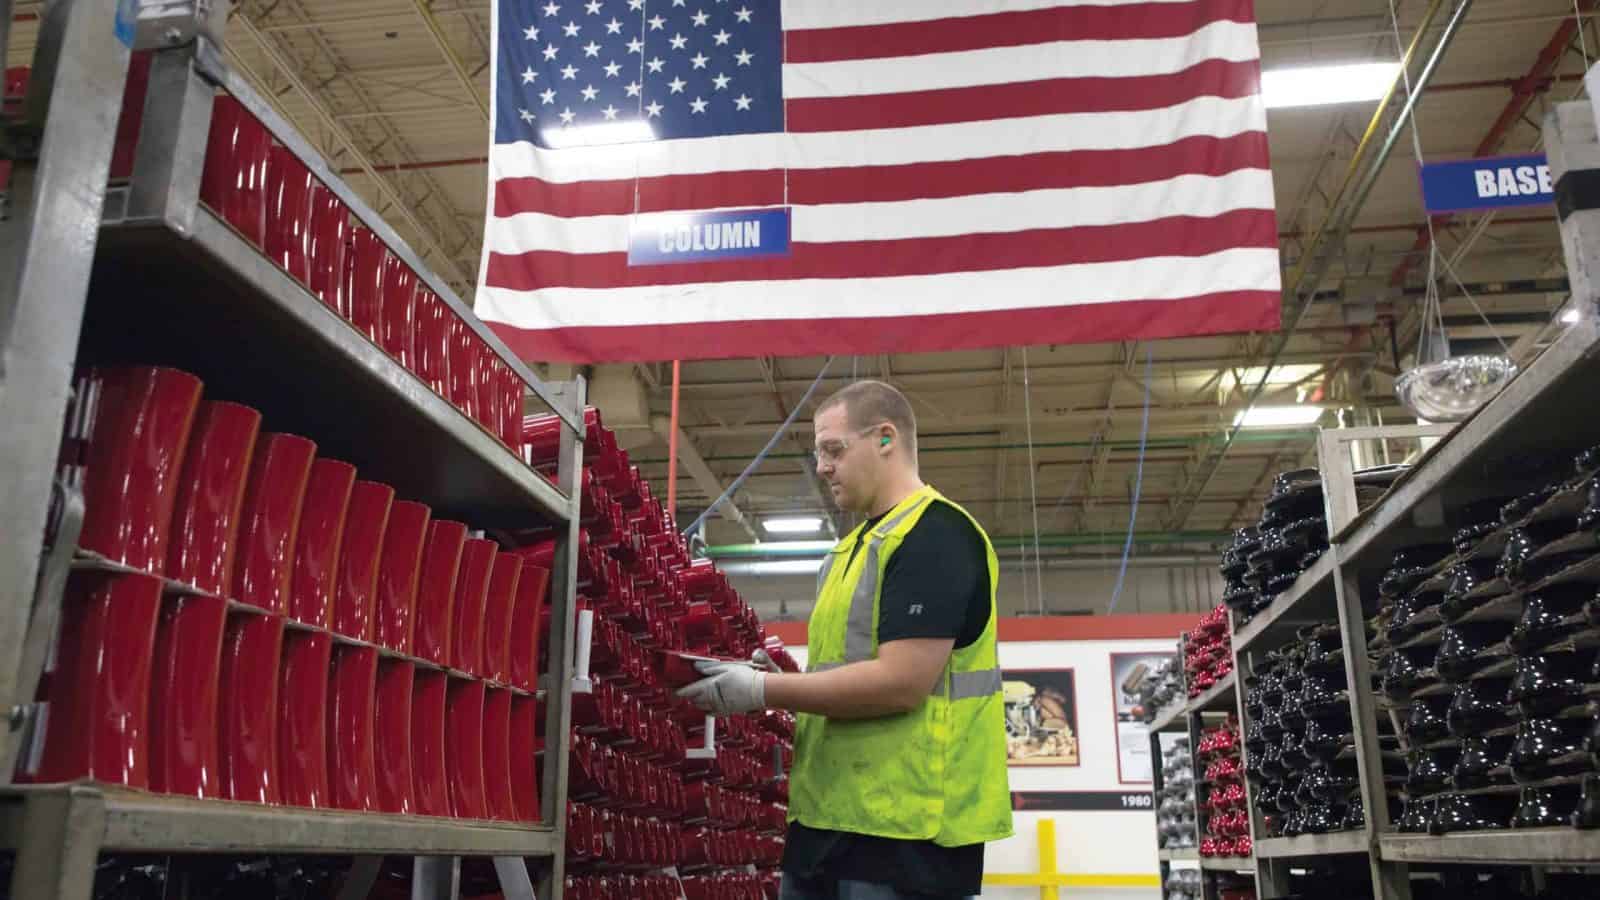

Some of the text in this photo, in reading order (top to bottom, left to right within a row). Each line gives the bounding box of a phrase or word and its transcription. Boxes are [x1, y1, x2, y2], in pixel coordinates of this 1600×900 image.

[1474, 165, 1553, 198] BASE
[657, 220, 761, 253] COLUMN
[1121, 795, 1151, 807] 1980
